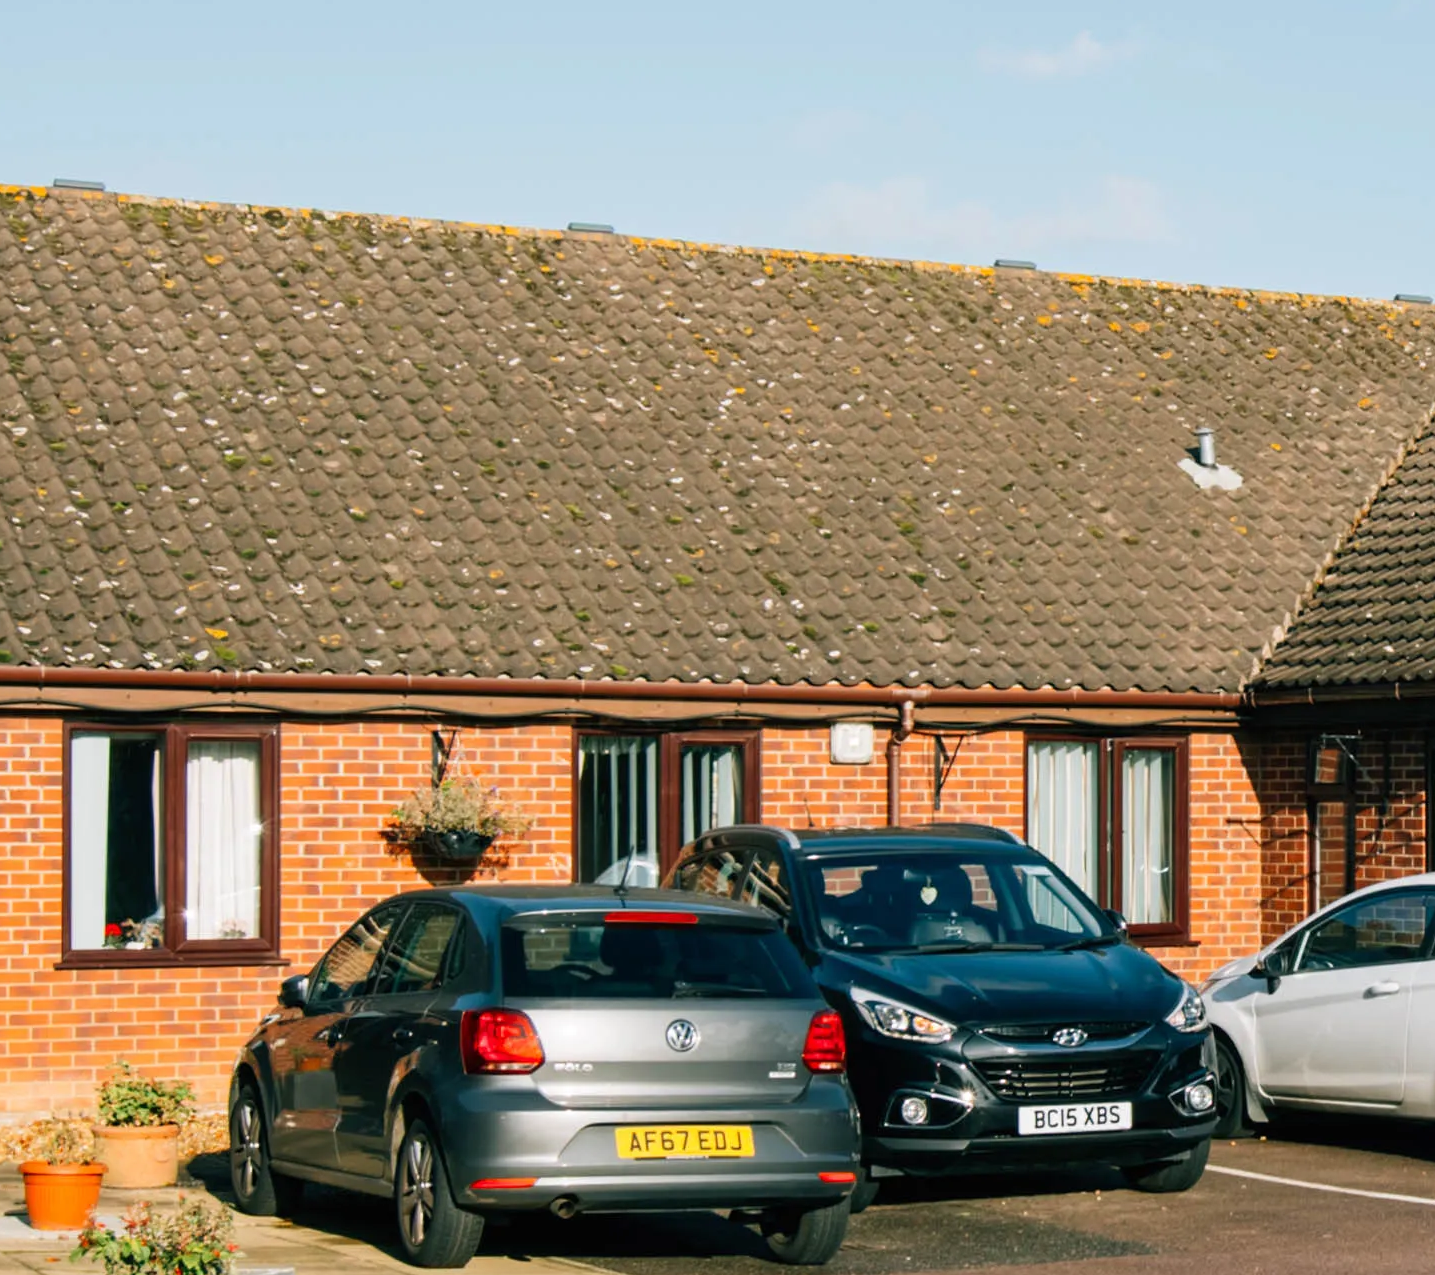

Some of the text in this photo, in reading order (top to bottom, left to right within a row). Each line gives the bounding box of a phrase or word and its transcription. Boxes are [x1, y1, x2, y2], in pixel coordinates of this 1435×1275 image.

[1034, 1105, 1120, 1129] BC15 XBS
[630, 1130, 742, 1153] AF67 EDJ
